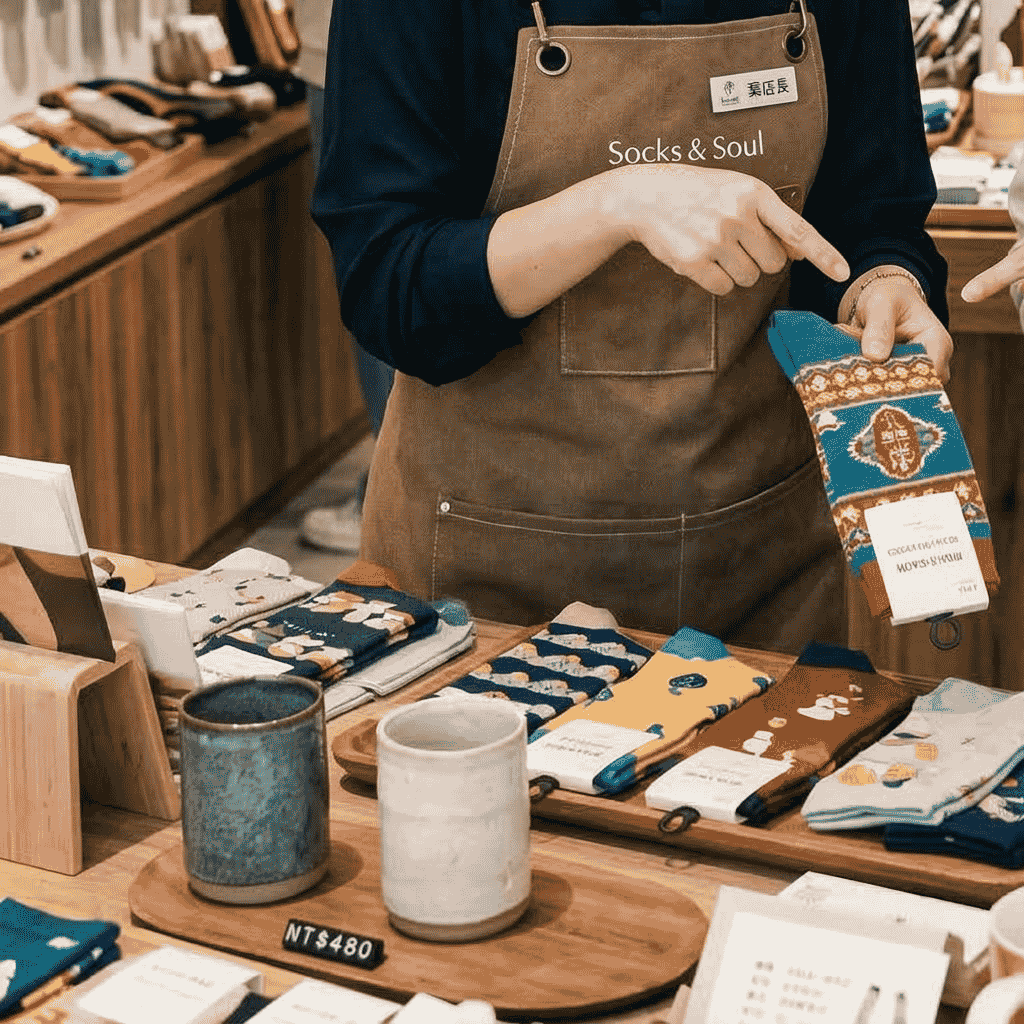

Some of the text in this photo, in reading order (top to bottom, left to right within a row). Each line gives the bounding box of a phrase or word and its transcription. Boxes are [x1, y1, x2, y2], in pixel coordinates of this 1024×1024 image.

[608, 129, 764, 165] Socks & Soul
[285, 923, 372, 959] NT$480
